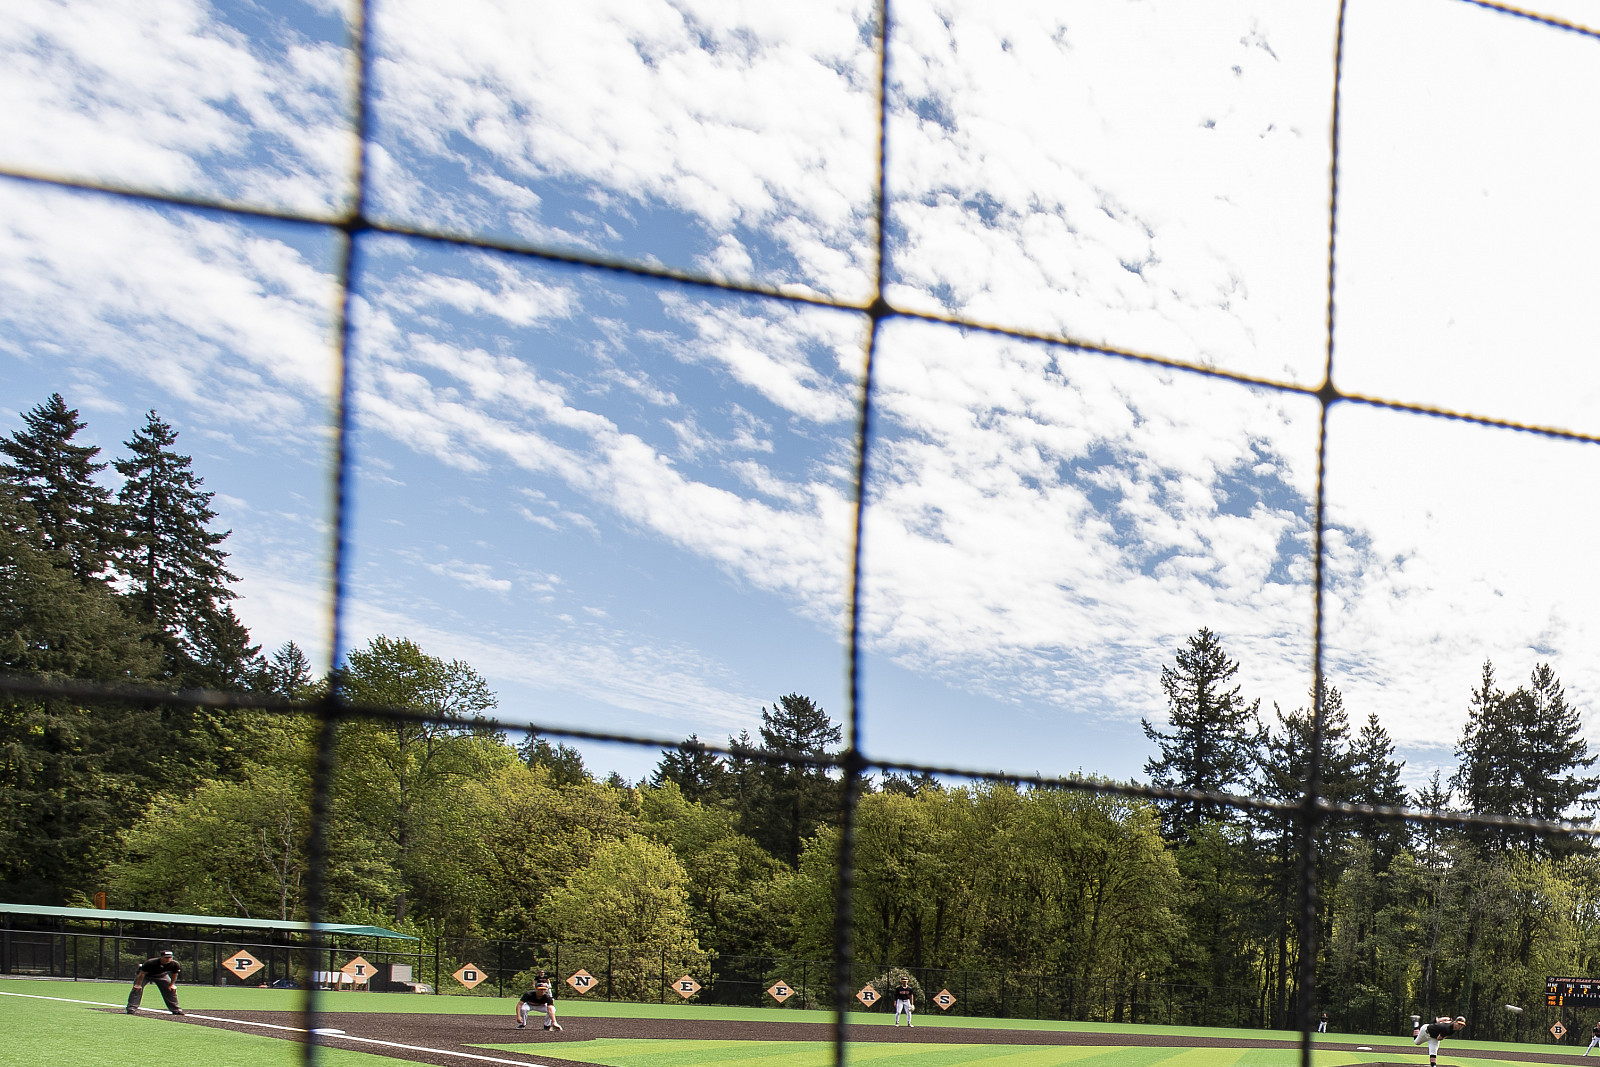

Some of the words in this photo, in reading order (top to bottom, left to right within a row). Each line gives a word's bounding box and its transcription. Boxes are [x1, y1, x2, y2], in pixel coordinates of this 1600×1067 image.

[235, 958, 253, 970] P
[355, 965, 365, 976] I
[463, 970, 477, 981] O
[574, 975, 591, 986] N
[680, 981, 693, 992] E
[775, 986, 788, 996] E
[862, 991, 876, 1001] R
[939, 995, 950, 1005] S
